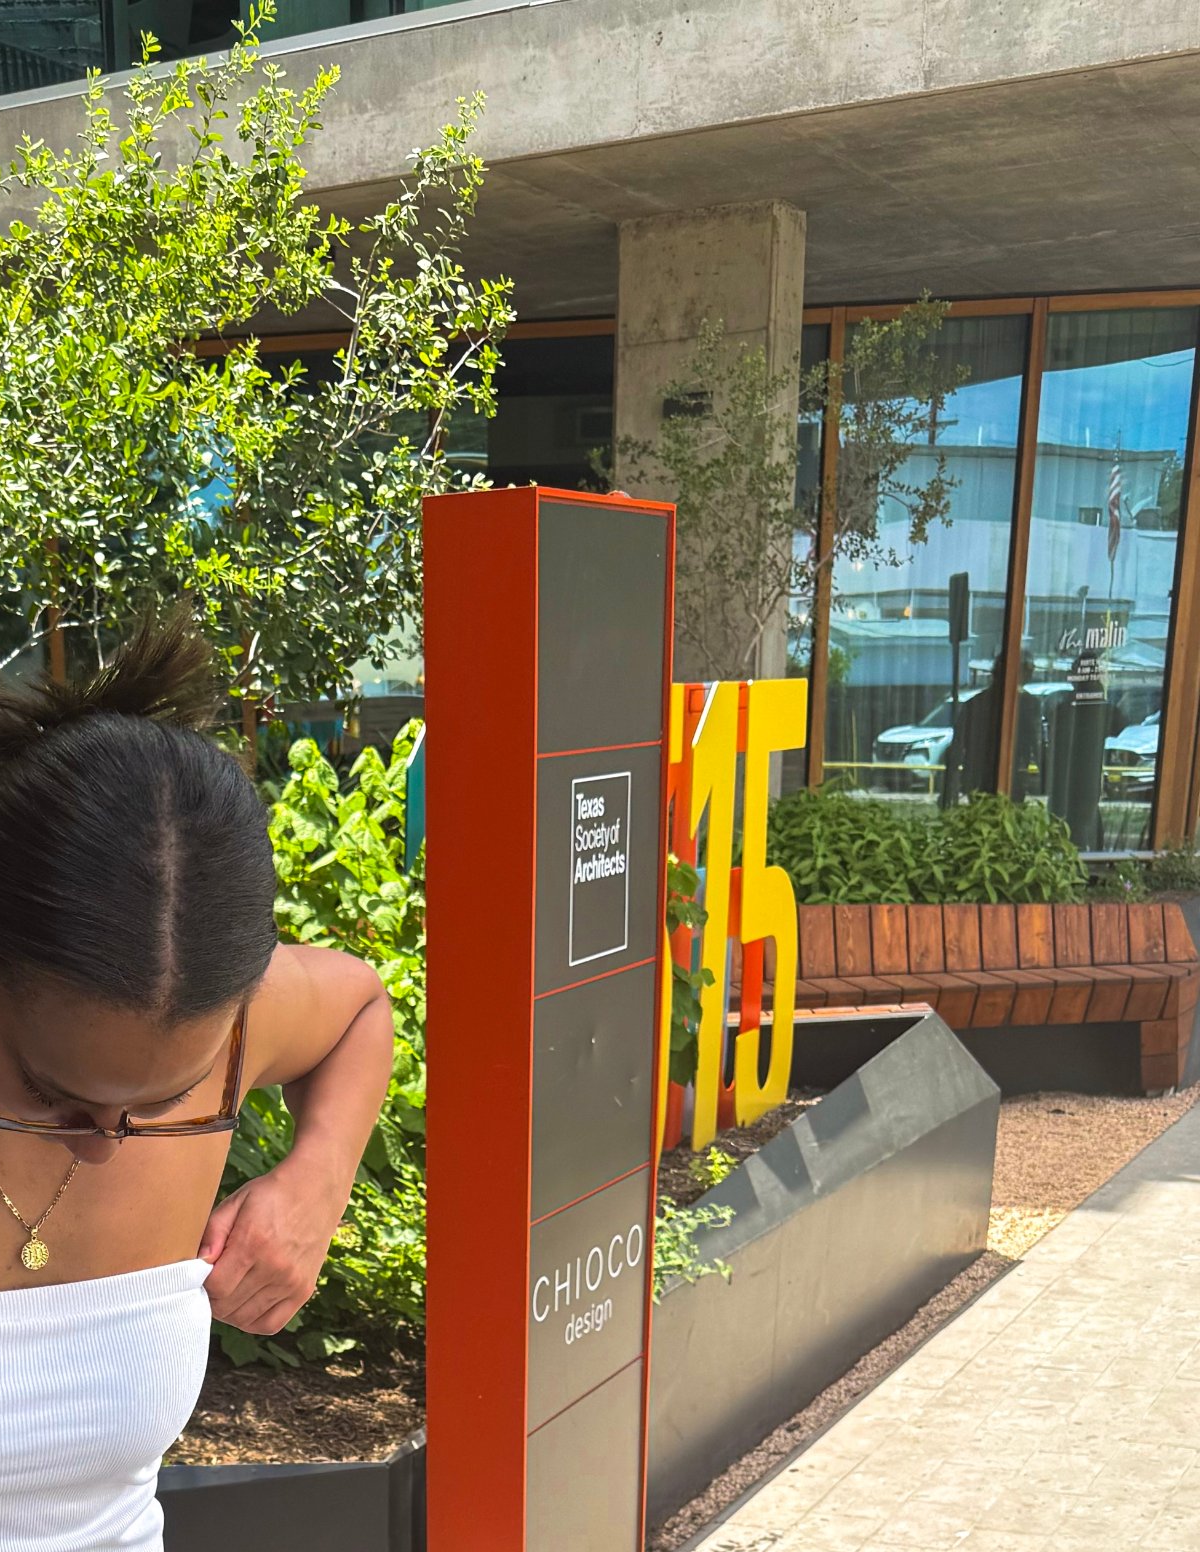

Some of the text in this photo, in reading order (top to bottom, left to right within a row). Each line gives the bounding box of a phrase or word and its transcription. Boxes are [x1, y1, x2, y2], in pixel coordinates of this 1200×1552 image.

[1085, 620, 1127, 649] malin
[576, 793, 605, 820] Texas
[575, 817, 620, 852] Society of
[574, 850, 625, 885] Architects
[532, 1224, 643, 1322] CHIOCO
[565, 1298, 613, 1345] design
